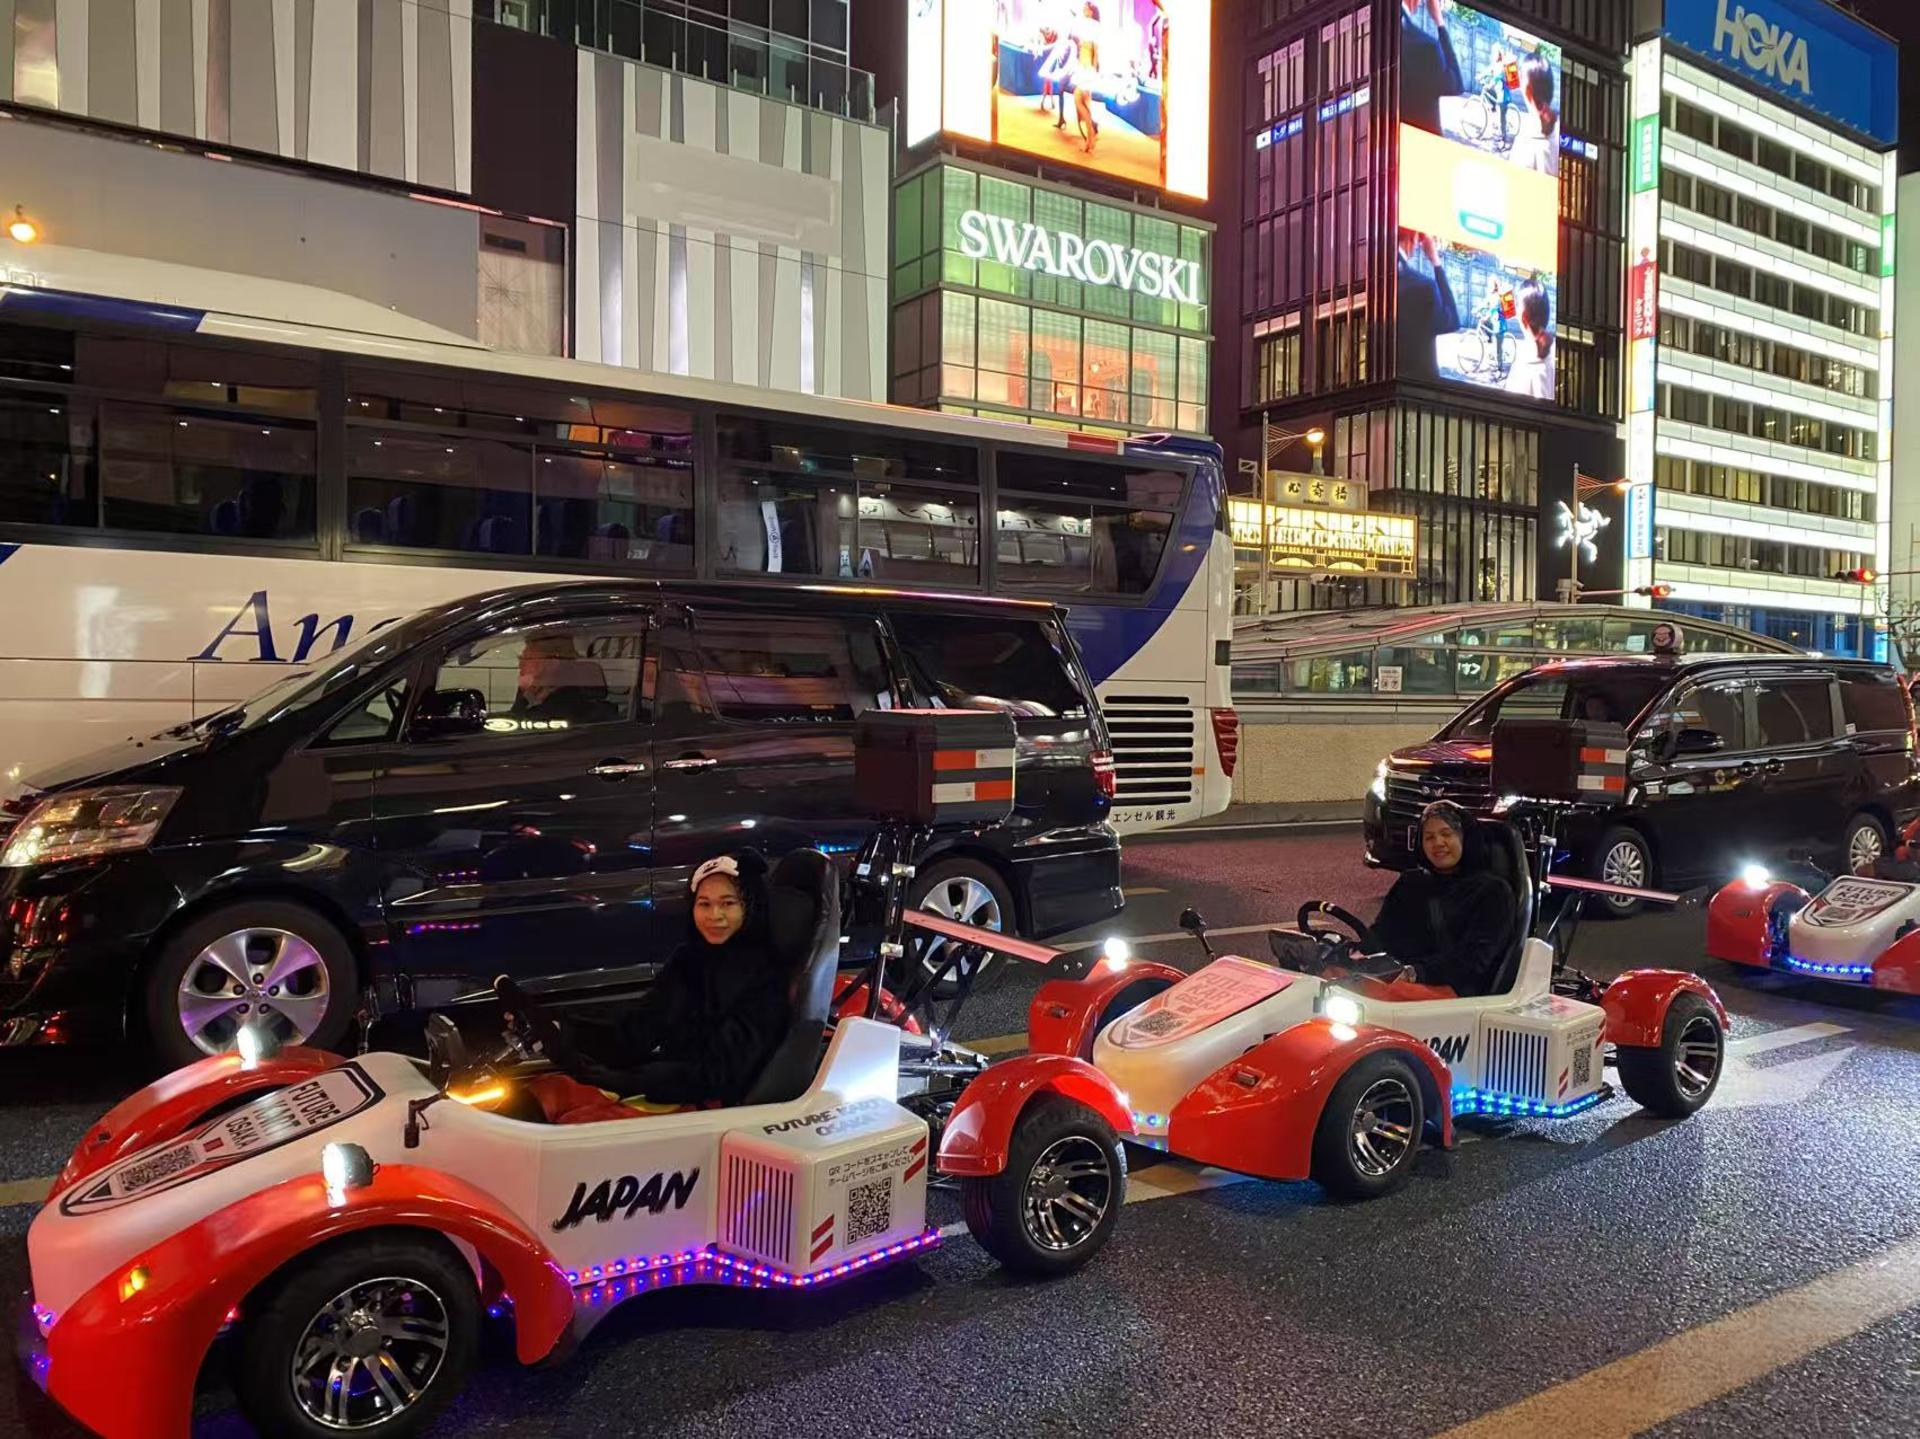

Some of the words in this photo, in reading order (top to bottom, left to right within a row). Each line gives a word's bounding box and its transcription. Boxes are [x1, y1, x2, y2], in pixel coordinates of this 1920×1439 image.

[1714, 0, 1810, 94] HOKA
[959, 209, 1200, 305] SWAROVSKI
[1113, 808, 1175, 822] エンゼル観光
[1836, 884, 1900, 897] FUTURE
[288, 1081, 341, 1125] FUTURE
[225, 1116, 261, 1150] OSAKA
[762, 1110, 838, 1135] FUTURE
[828, 1165, 841, 1177] QR
[551, 1166, 700, 1232] JAPAN
